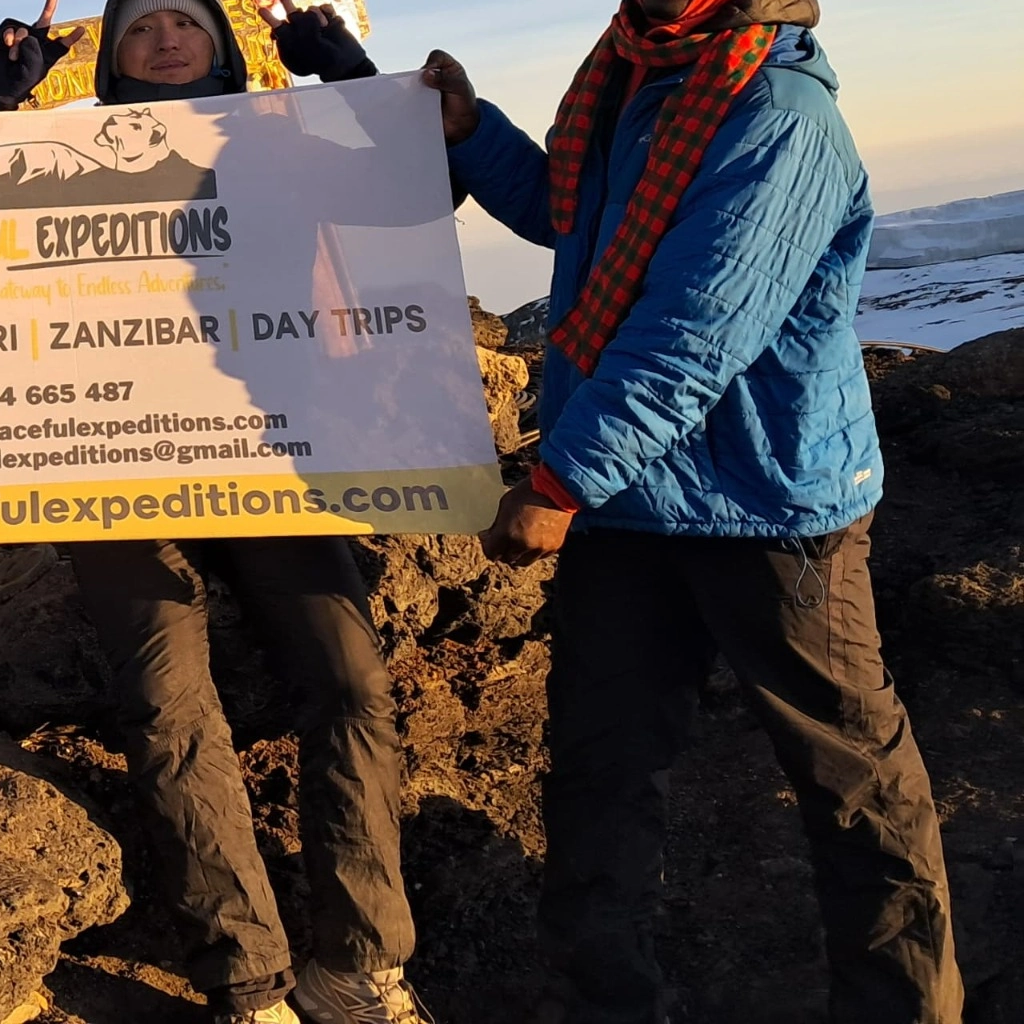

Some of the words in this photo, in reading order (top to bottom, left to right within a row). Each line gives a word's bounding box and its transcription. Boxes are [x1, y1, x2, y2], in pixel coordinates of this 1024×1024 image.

[36, 206, 231, 258] EXPEDITIONS
[56, 277, 72, 298] to
[76, 272, 132, 297] Endless
[50, 315, 220, 350] ZANZIBAR
[252, 310, 319, 340] DAY
[331, 304, 427, 337] TRIPS
[26, 383, 76, 405] 665
[85, 381, 134, 402] 487
